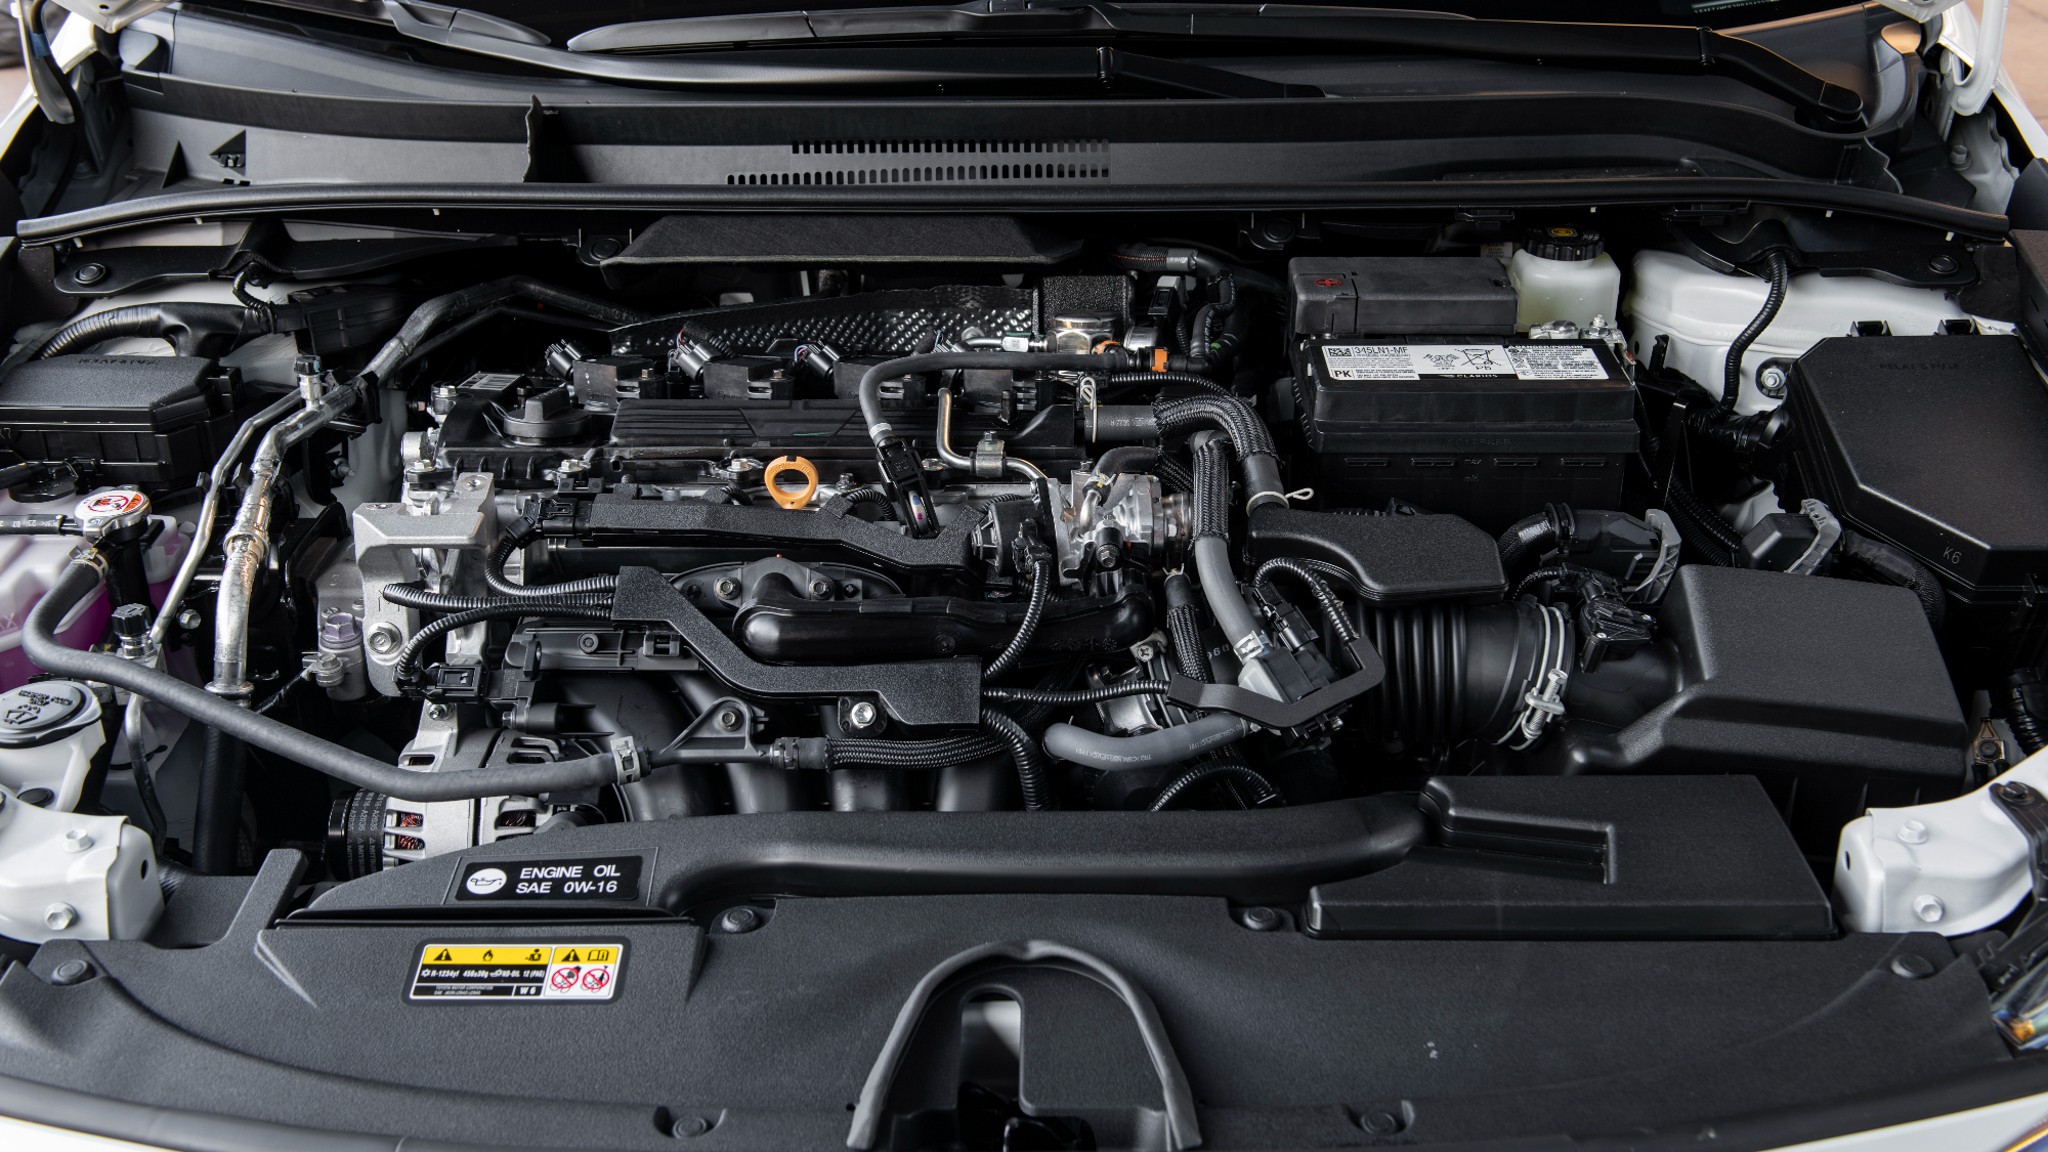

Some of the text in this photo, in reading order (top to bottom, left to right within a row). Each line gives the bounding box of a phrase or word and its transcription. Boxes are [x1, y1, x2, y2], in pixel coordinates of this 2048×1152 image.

[1335, 370, 1352, 378] PK
[1942, 545, 1962, 565] K6
[520, 864, 621, 880] ENGINE OIL
[515, 880, 618, 894] SAE 0W-16
[520, 986, 530, 995] W
